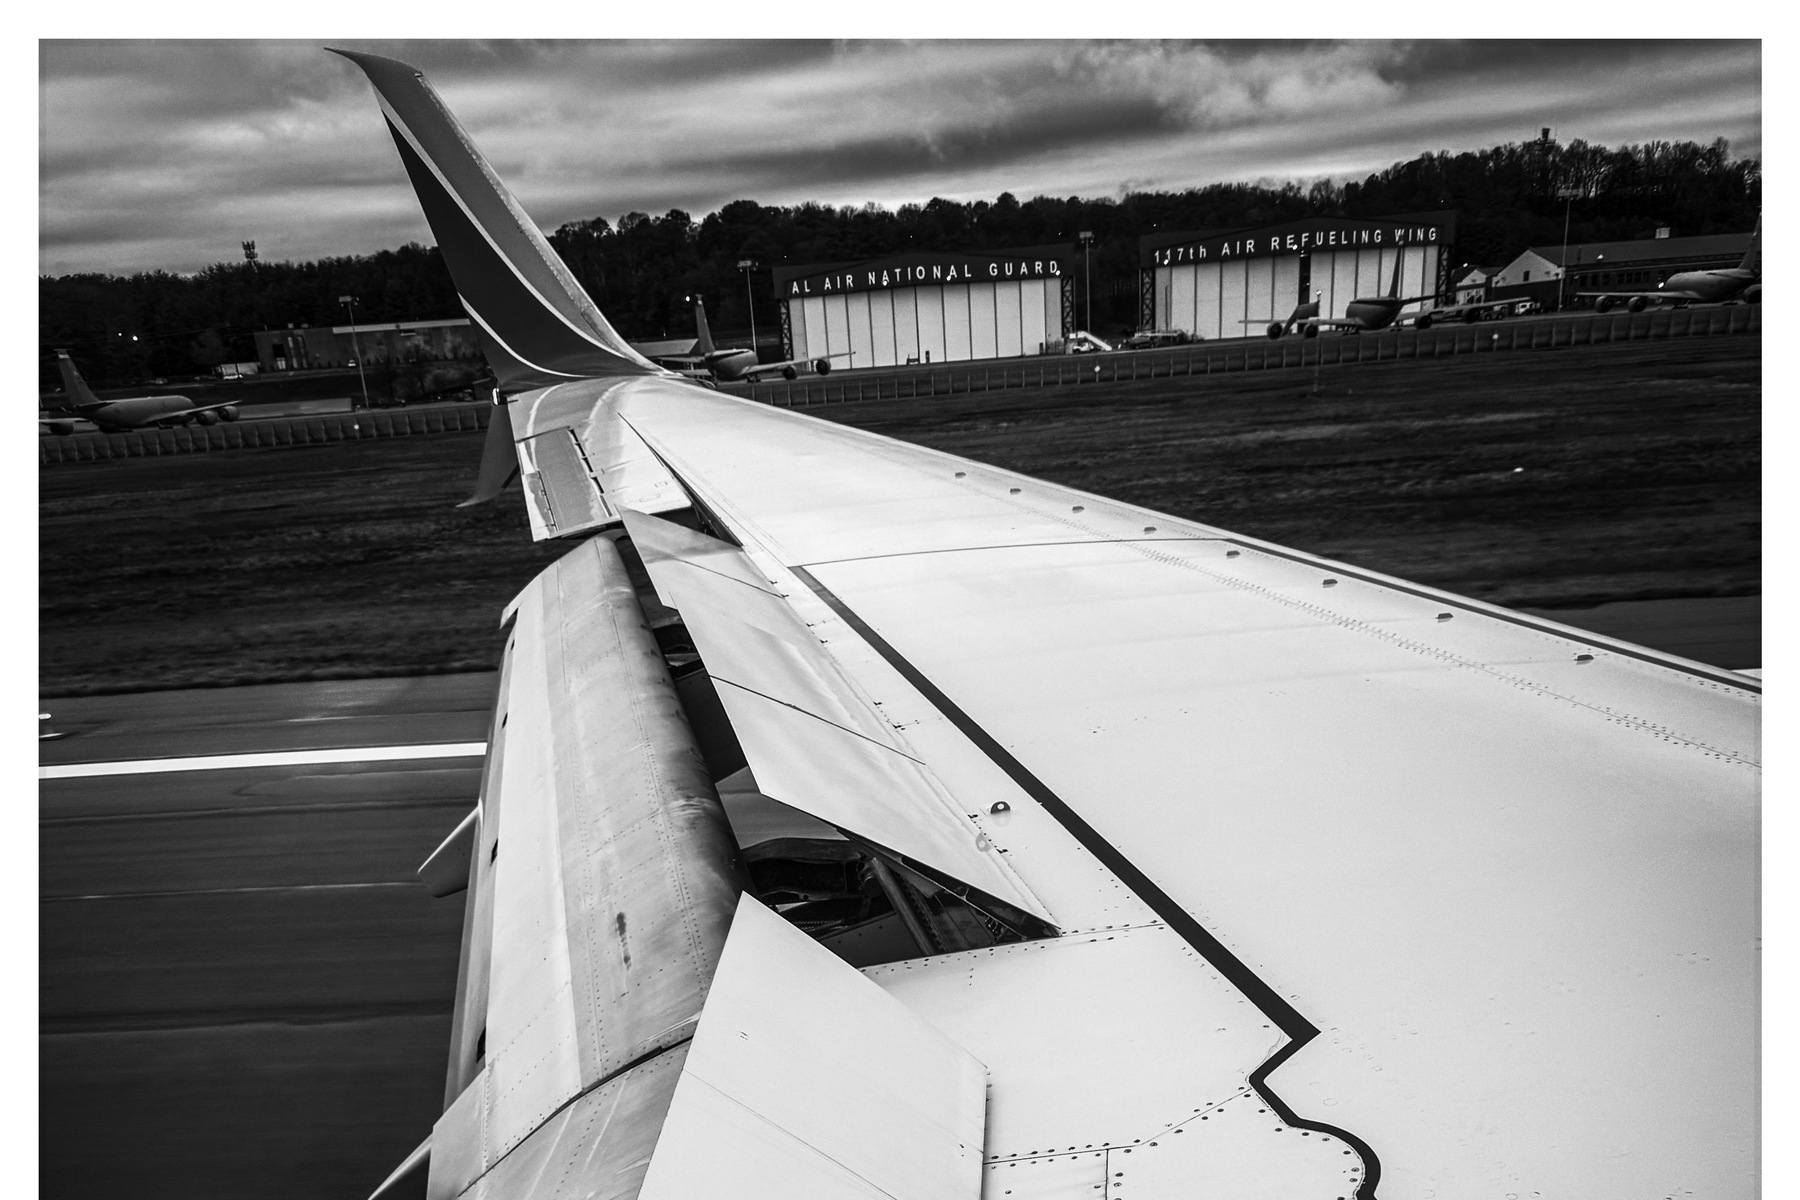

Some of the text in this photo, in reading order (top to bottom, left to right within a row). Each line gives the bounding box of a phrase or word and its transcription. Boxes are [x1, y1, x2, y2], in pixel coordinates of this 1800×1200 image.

[1154, 227, 1437, 263] 117th AIR REFUELING WING
[792, 260, 1058, 294] AL AIR NATIONAL GUARD
